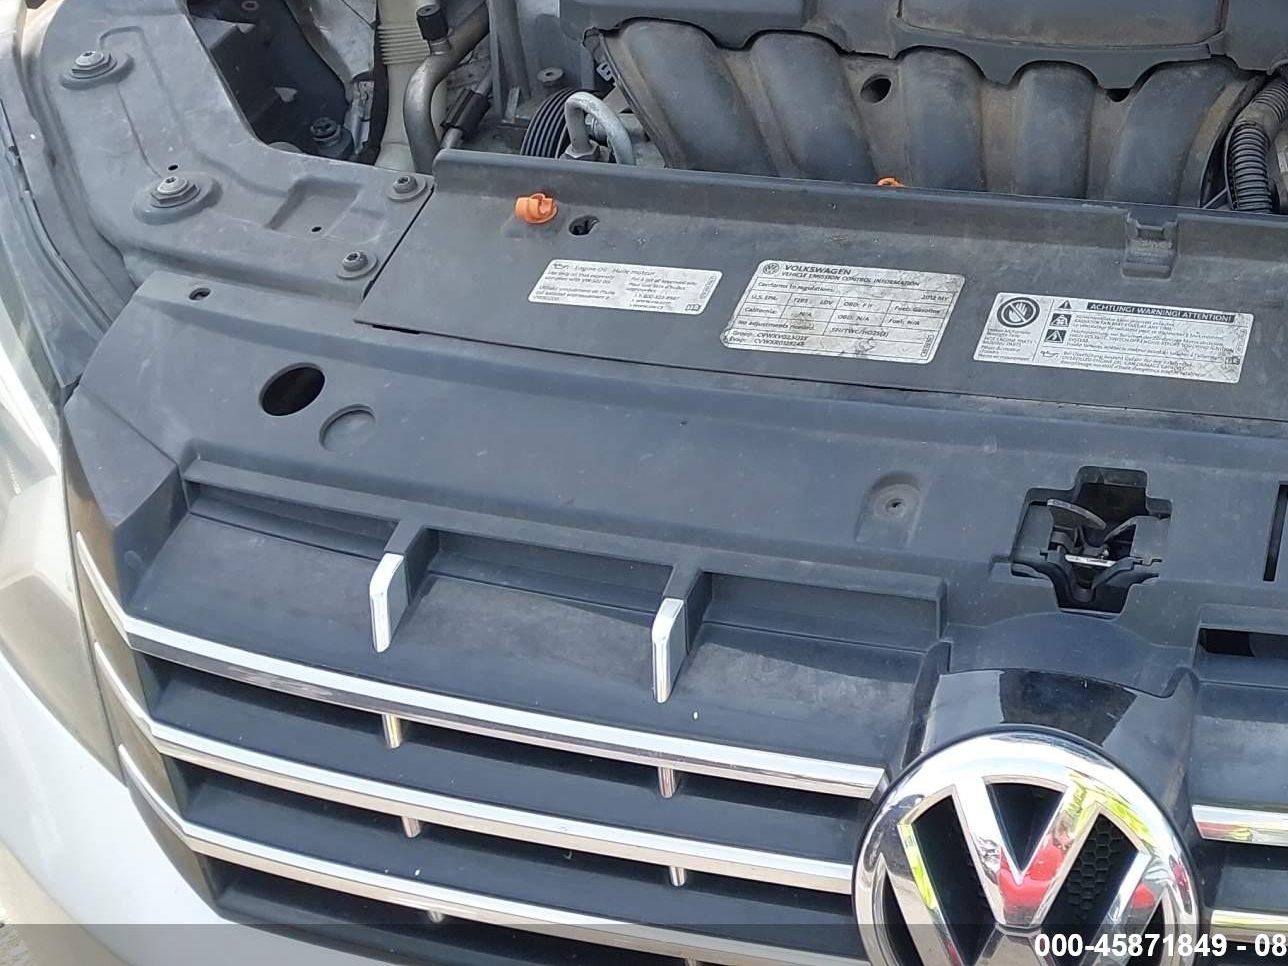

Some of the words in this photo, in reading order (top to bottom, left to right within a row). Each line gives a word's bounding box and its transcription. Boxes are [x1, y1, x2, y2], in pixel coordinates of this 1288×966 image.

[785, 264, 852, 275] VOLKSWAGEN
[874, 278, 920, 286] INFORMATION
[1090, 304, 1134, 313] ACHTUNG!
[1137, 307, 1180, 317] WARNING!
[1182, 312, 1232, 322] ATTENTION!
